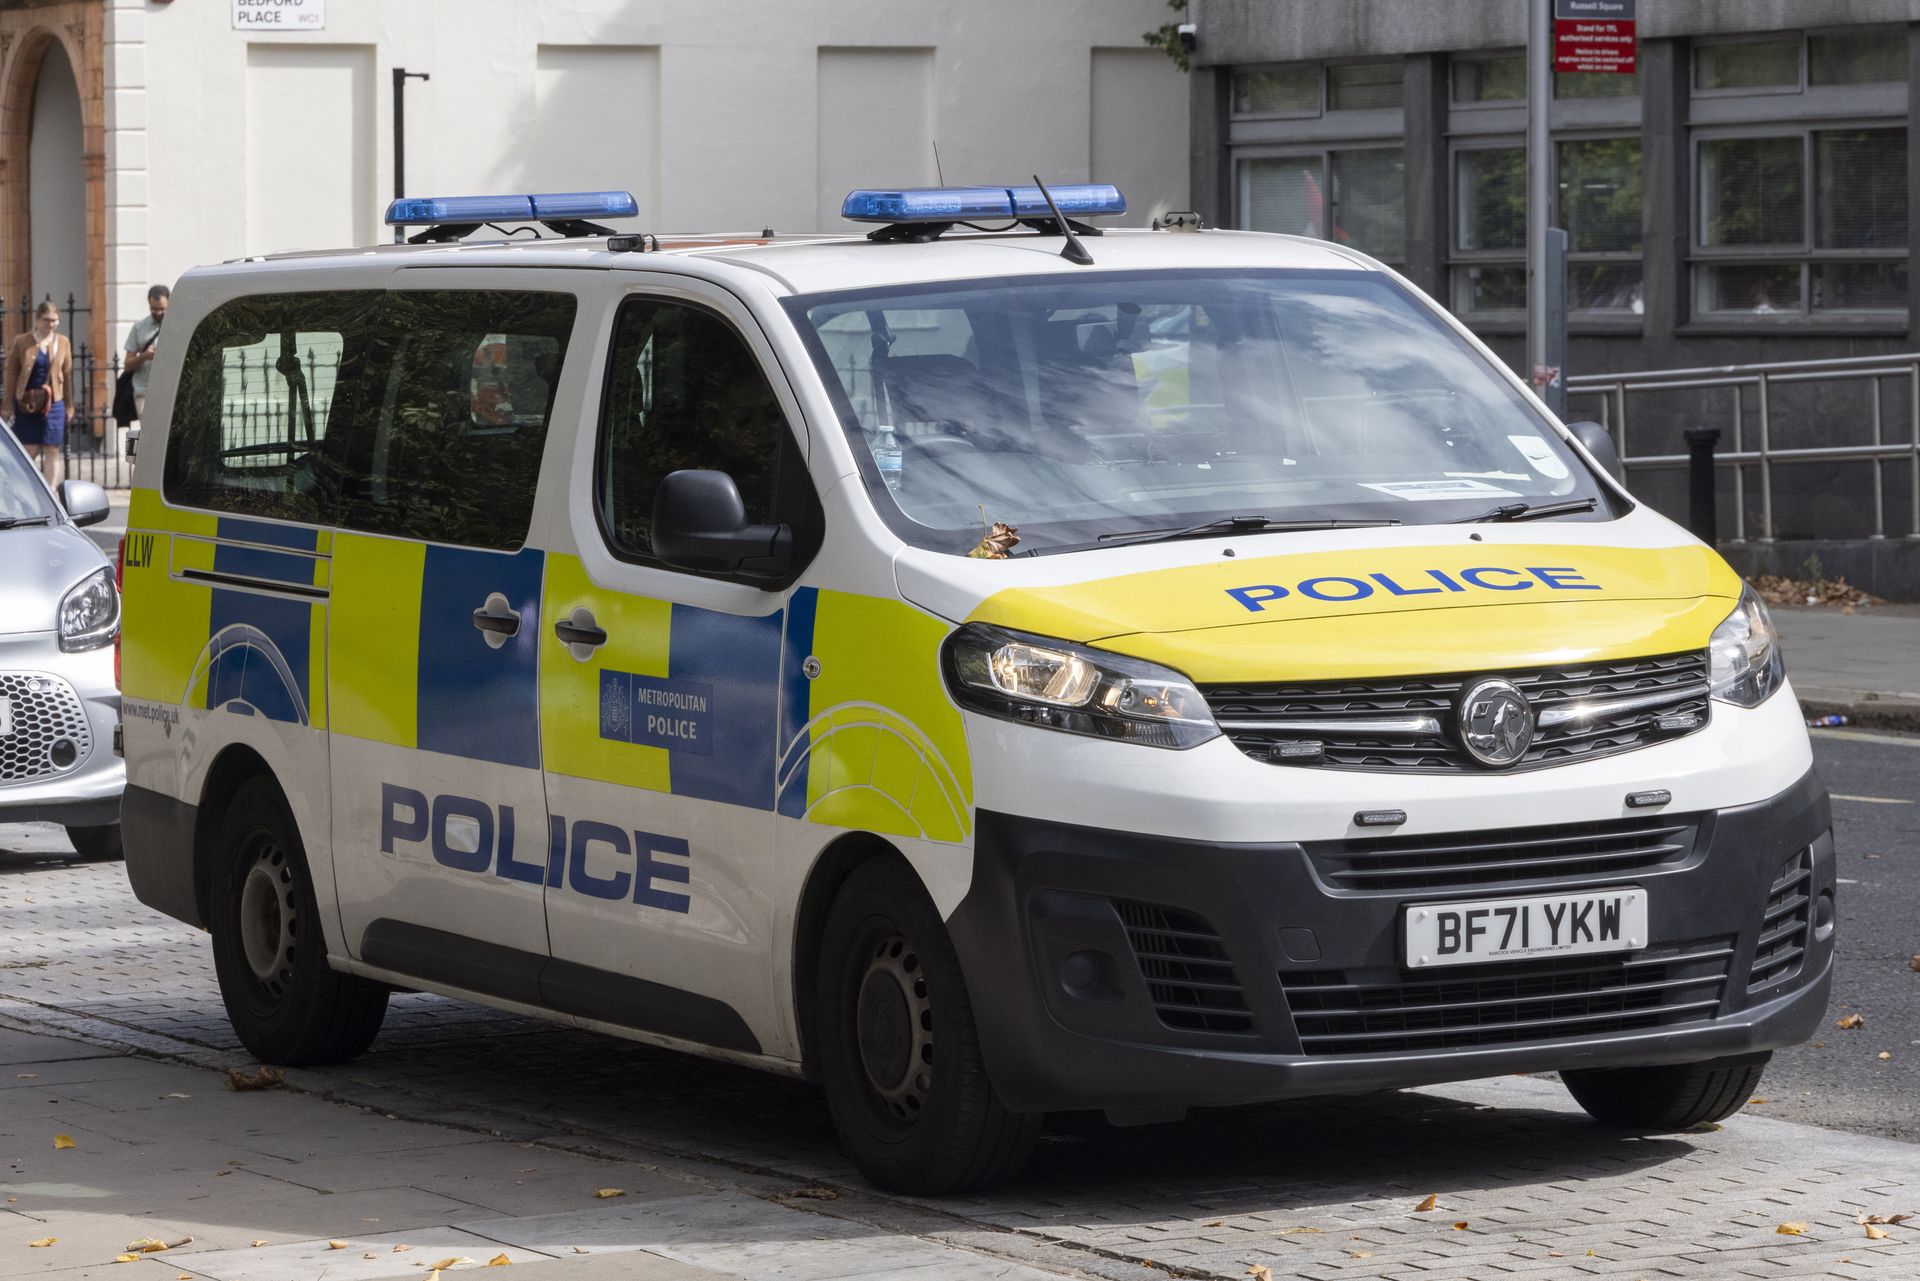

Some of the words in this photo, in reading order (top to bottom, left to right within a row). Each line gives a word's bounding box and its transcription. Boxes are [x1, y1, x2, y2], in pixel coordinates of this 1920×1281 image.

[238, 11, 282, 23] PLACE
[298, 14, 319, 23] WC1
[1570, 1, 1597, 10] Russell
[1599, 2, 1624, 11] Square
[1576, 24, 1594, 32] Stand
[1595, 24, 1605, 32] for
[126, 534, 154, 568] LLW
[1224, 567, 1603, 612] POLICE
[638, 687, 707, 713] METROPOLITAN
[122, 703, 180, 724] www.met.police.uk
[647, 714, 697, 740] POLICE
[380, 782, 691, 914] POLICE
[1437, 906, 1530, 955] BF71
[1544, 898, 1621, 946] YKW
